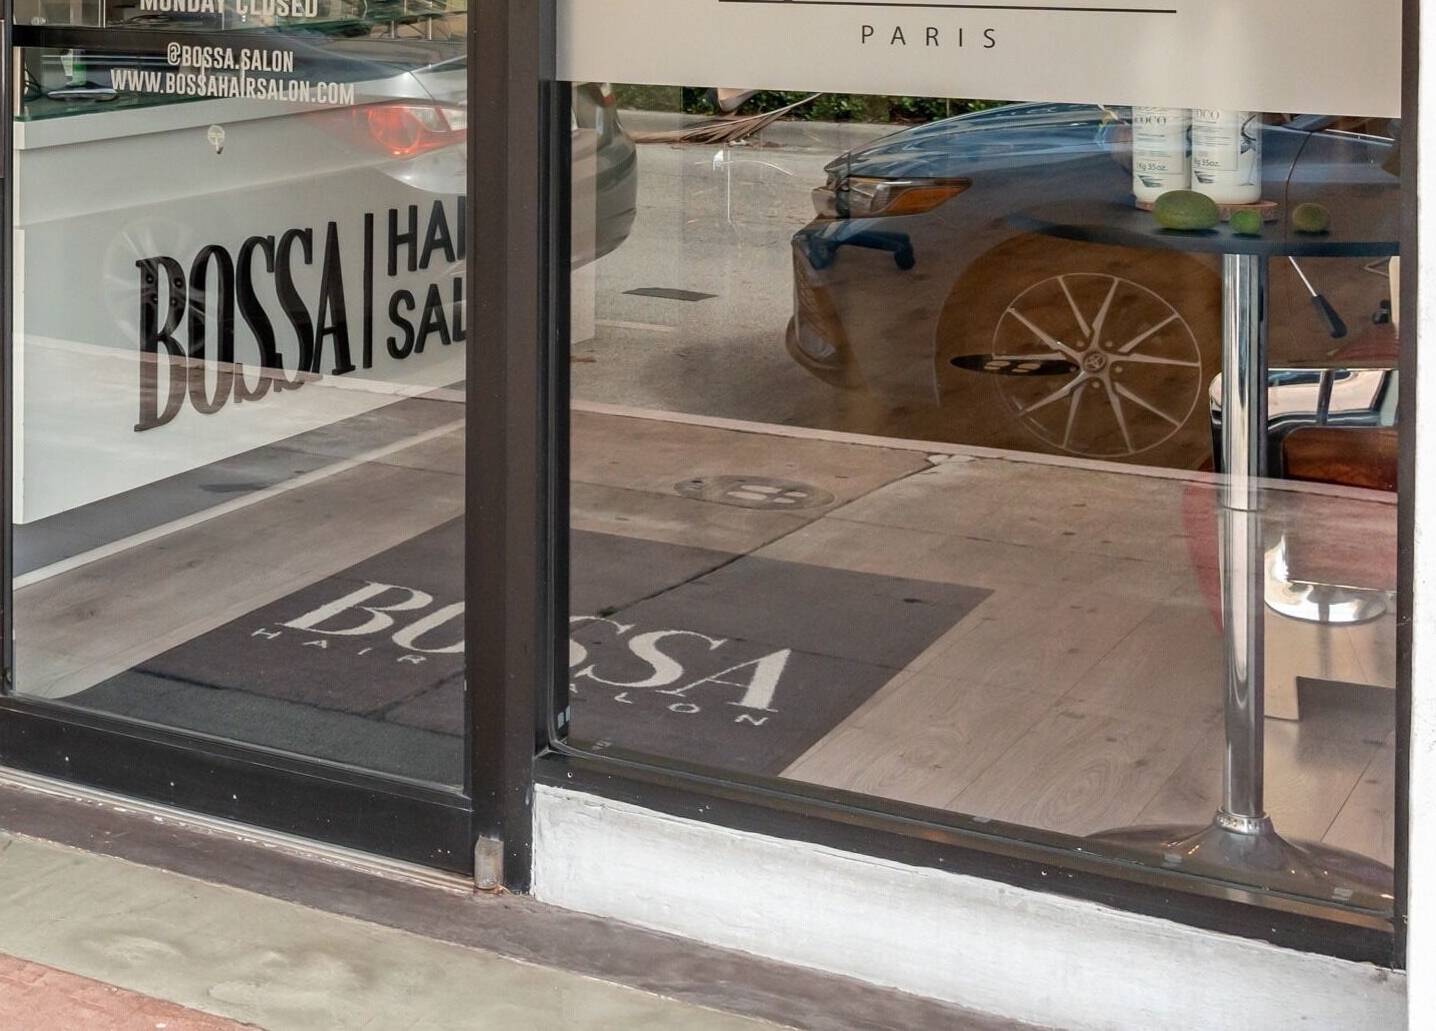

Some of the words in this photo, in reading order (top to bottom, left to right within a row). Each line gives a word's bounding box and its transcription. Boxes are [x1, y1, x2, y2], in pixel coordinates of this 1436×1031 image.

[861, 25, 996, 49] PARIS
[167, 42, 294, 73] @BOSSA.SALON
[110, 69, 354, 105] WWW.BOSSAHAIRSALON.COM
[134, 221, 356, 432] BOSSA
[252, 628, 427, 665] HAIR
